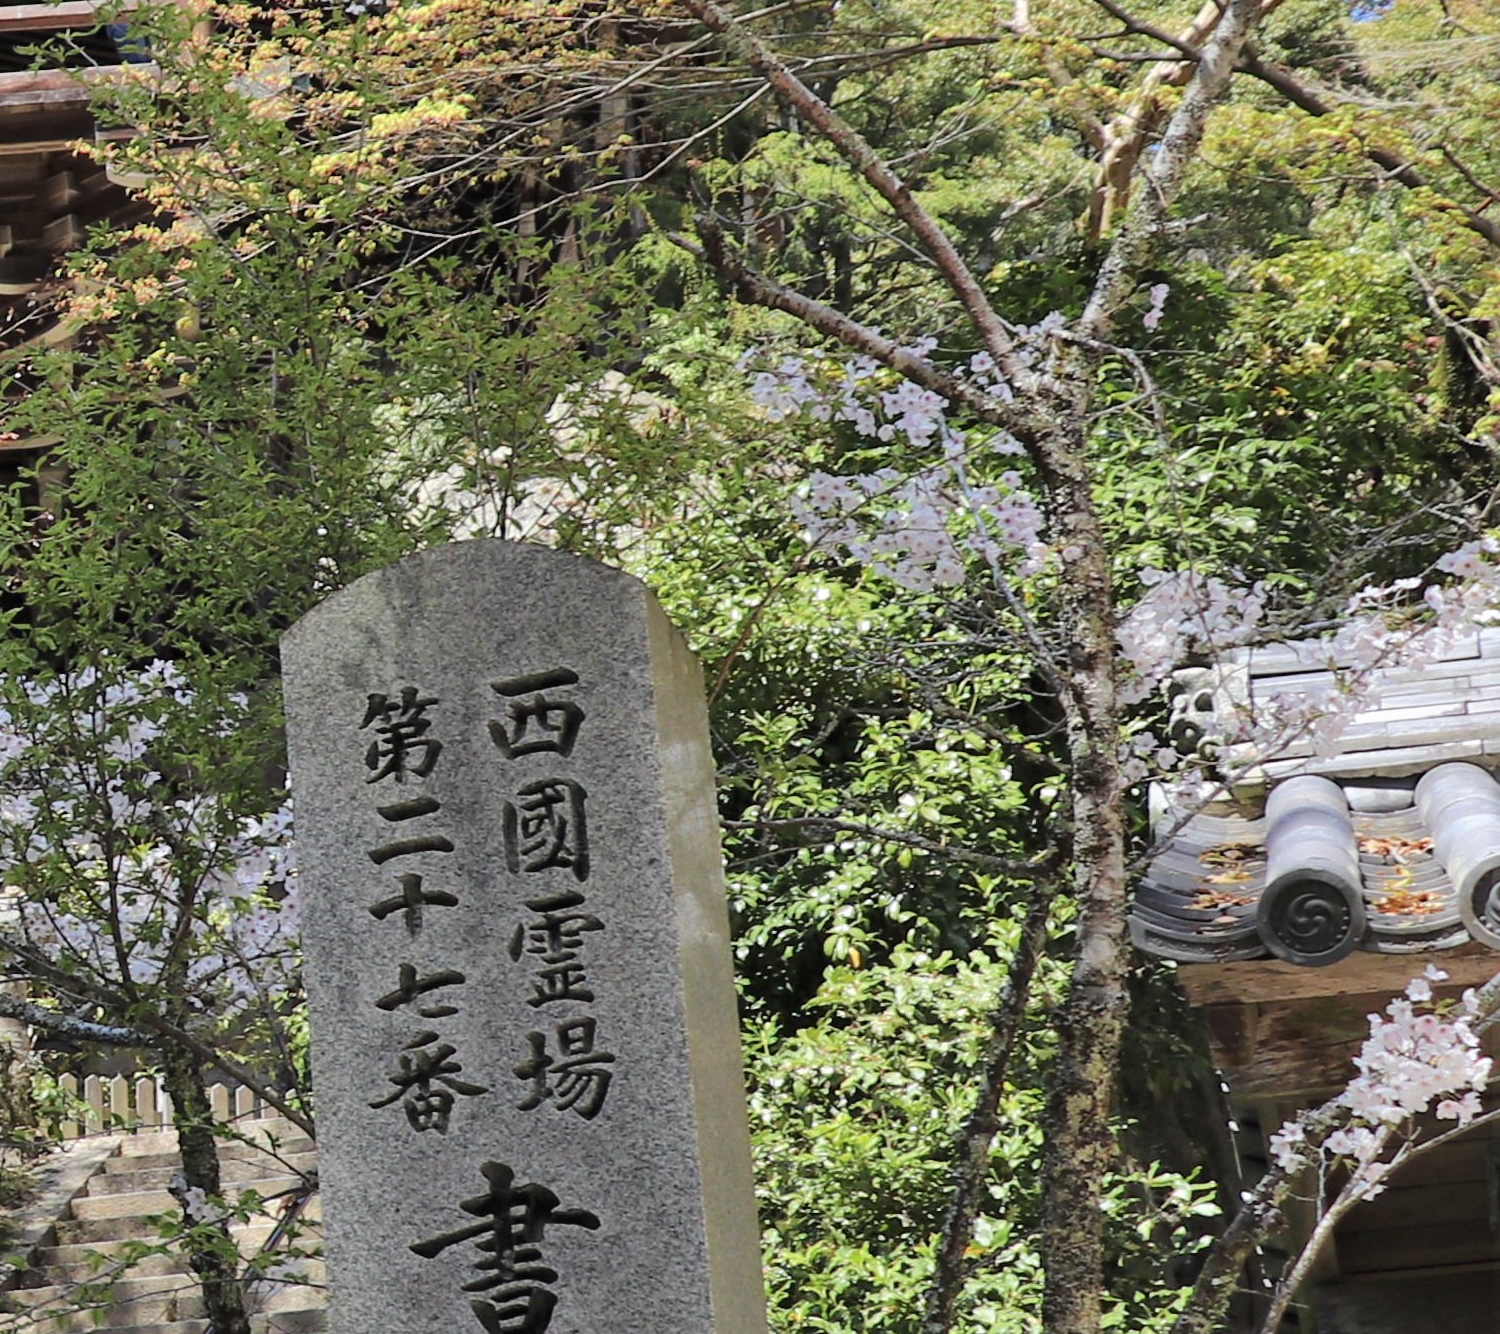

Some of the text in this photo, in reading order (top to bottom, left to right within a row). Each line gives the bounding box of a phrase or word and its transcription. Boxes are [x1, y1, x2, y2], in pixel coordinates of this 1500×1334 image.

[359, 685, 489, 1135] 第二十七番
[487, 667, 615, 1121] 西國霊場
